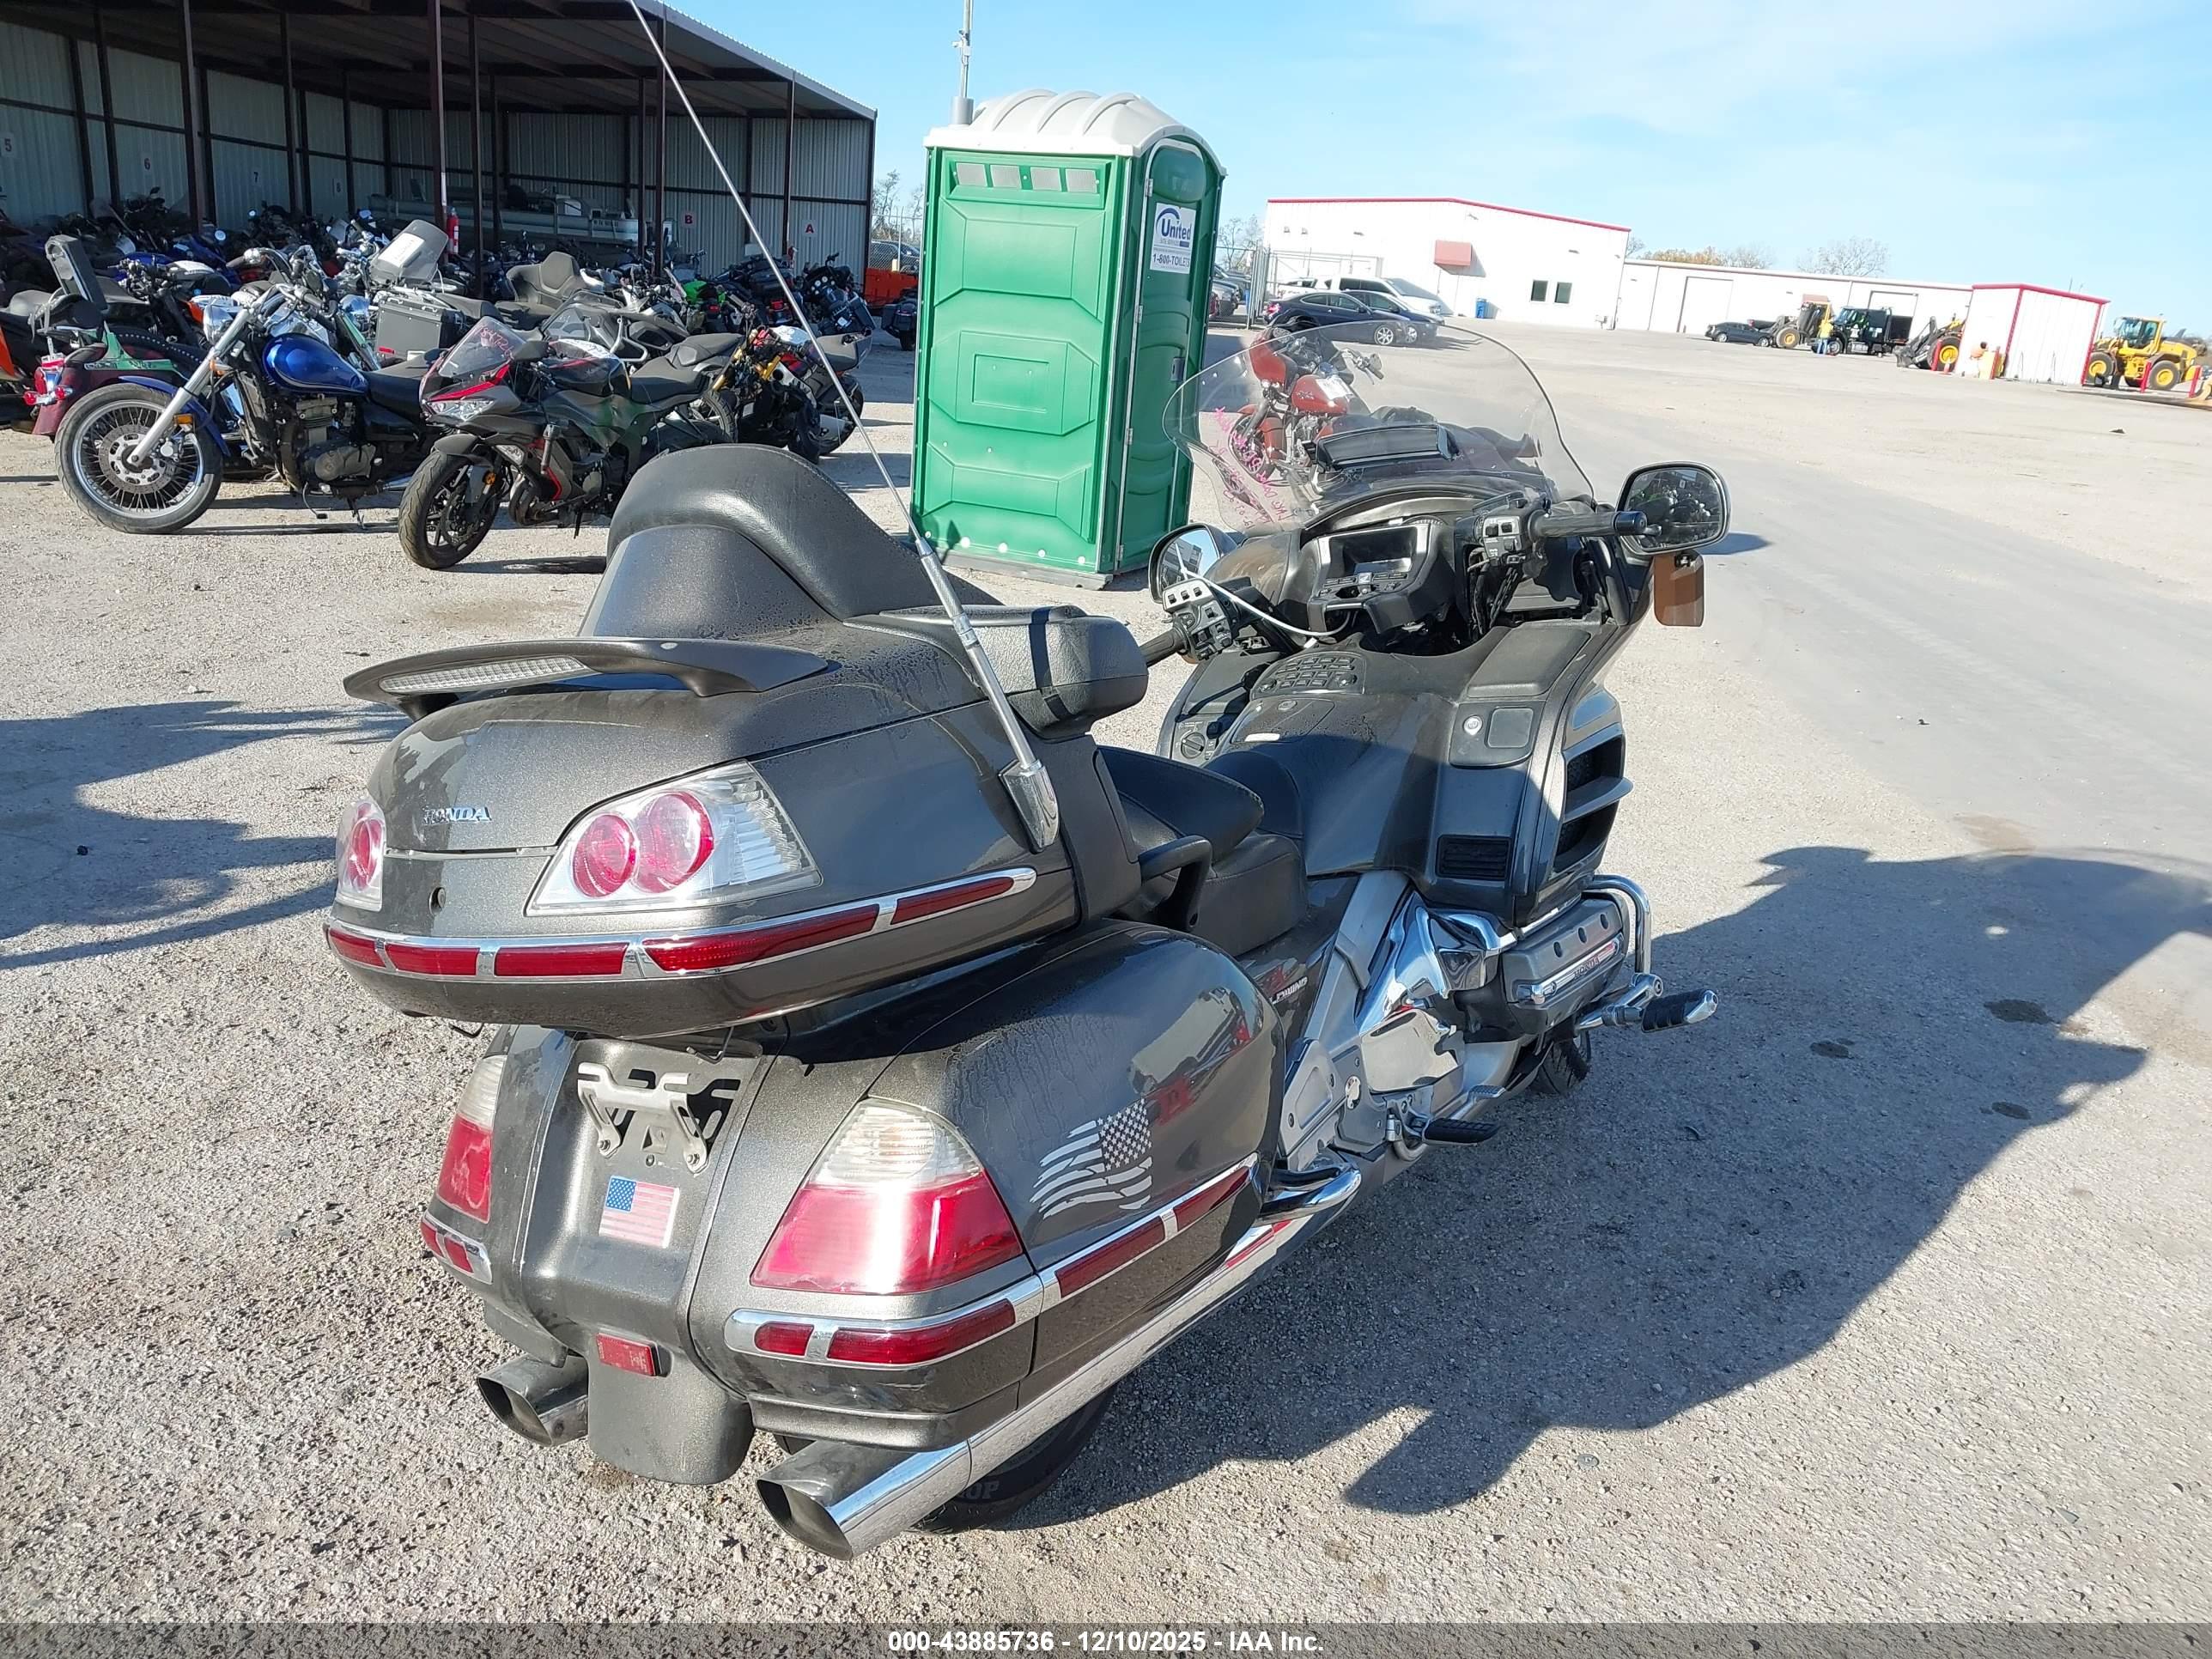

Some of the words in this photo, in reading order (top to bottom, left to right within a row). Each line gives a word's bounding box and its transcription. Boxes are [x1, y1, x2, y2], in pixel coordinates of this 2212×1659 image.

[4, 137, 12, 152] 5
[143, 158, 151, 171] 6
[252, 171, 259, 183] 7
[684, 214, 693, 224] B
[805, 223, 814, 234] A
[1161, 217, 1192, 240] United
[422, 806, 492, 825] HONDA
[1573, 956, 1601, 981] HONDA
